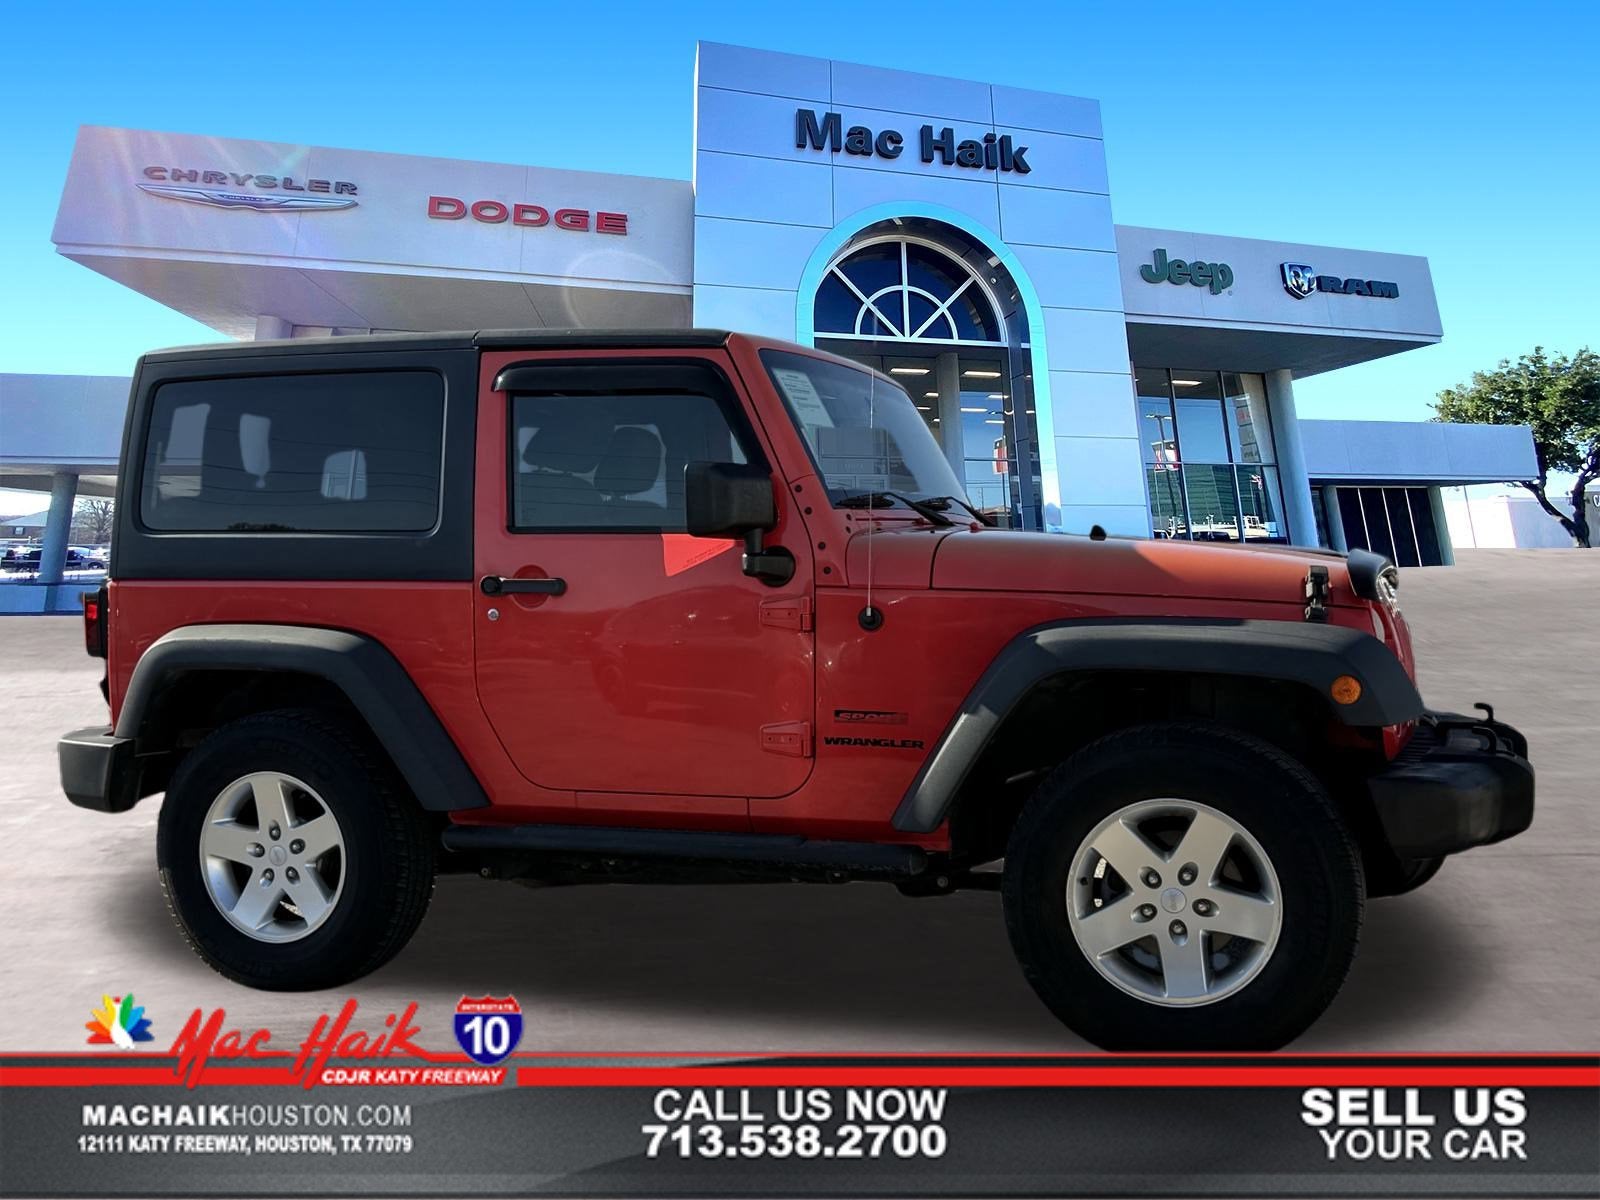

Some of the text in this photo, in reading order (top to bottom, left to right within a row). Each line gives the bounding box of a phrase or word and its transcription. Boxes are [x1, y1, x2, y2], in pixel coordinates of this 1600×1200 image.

[796, 108, 1032, 174] Mac Haik
[143, 166, 358, 196] CHRYSLER
[428, 196, 627, 236] DODGE
[1140, 248, 1234, 296] Jeep
[1316, 275, 1399, 299] RAM
[823, 736, 924, 750] WRANGLER
